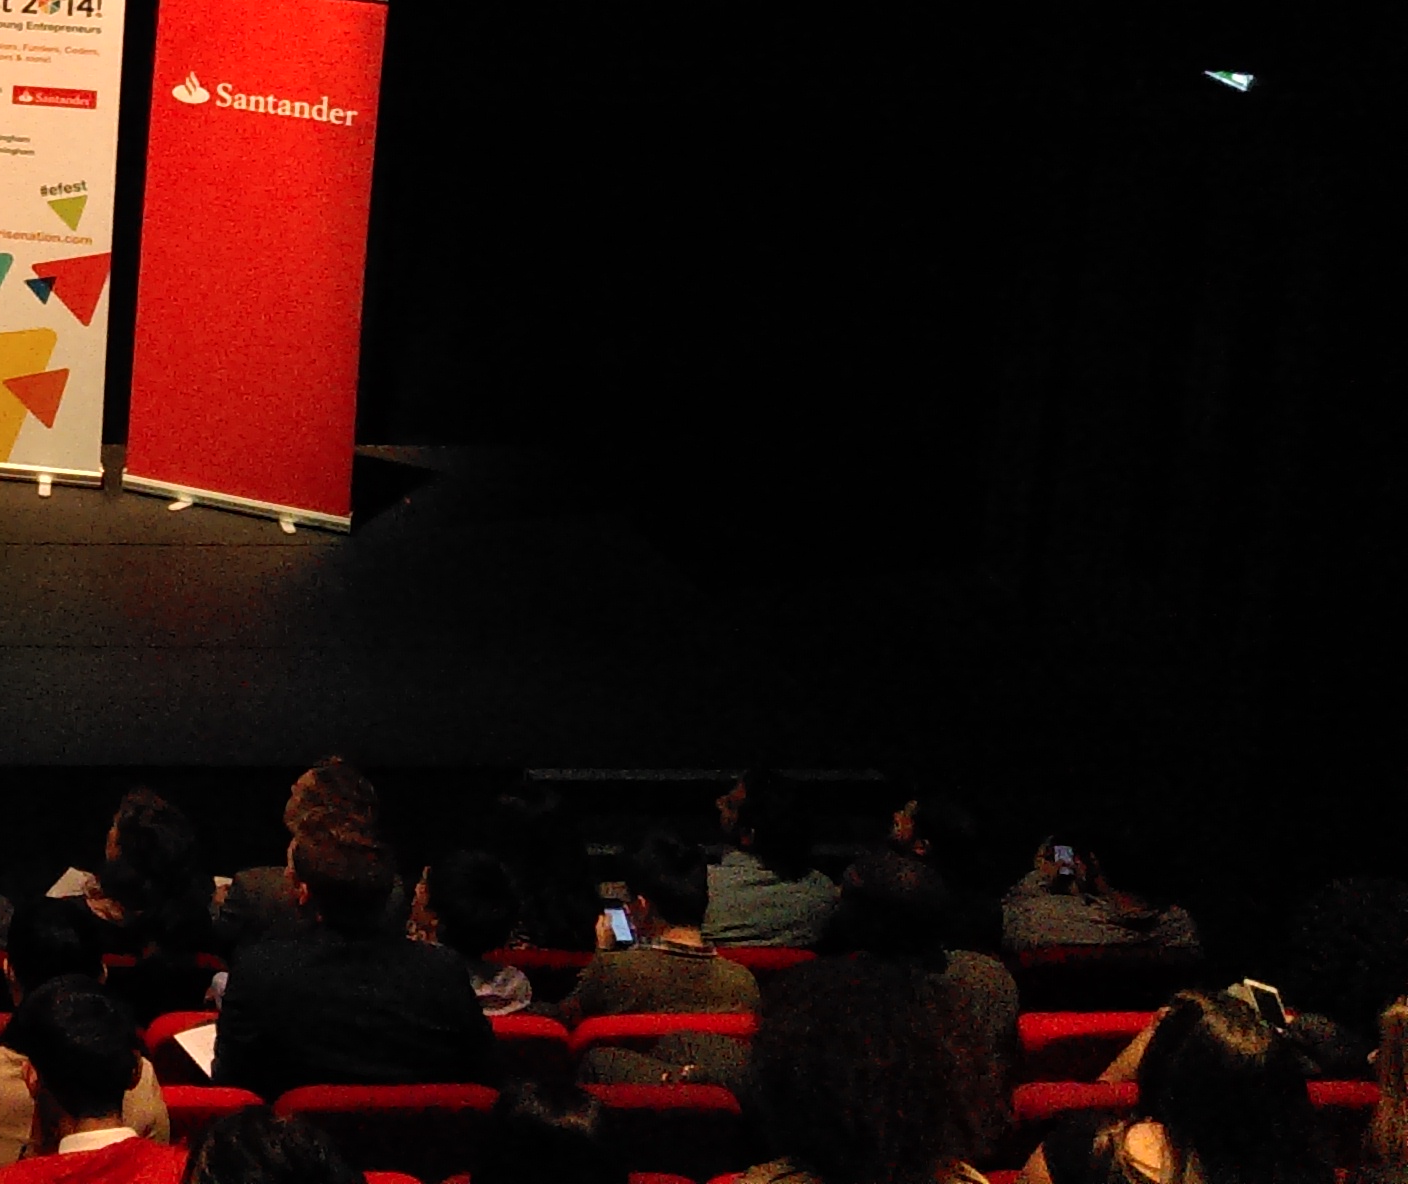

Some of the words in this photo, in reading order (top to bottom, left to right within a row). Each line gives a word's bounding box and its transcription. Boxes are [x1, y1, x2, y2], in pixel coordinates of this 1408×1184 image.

[26, 21, 102, 34] Entrepreneurs
[215, 82, 359, 127] Santander
[40, 180, 88, 197] #efest
